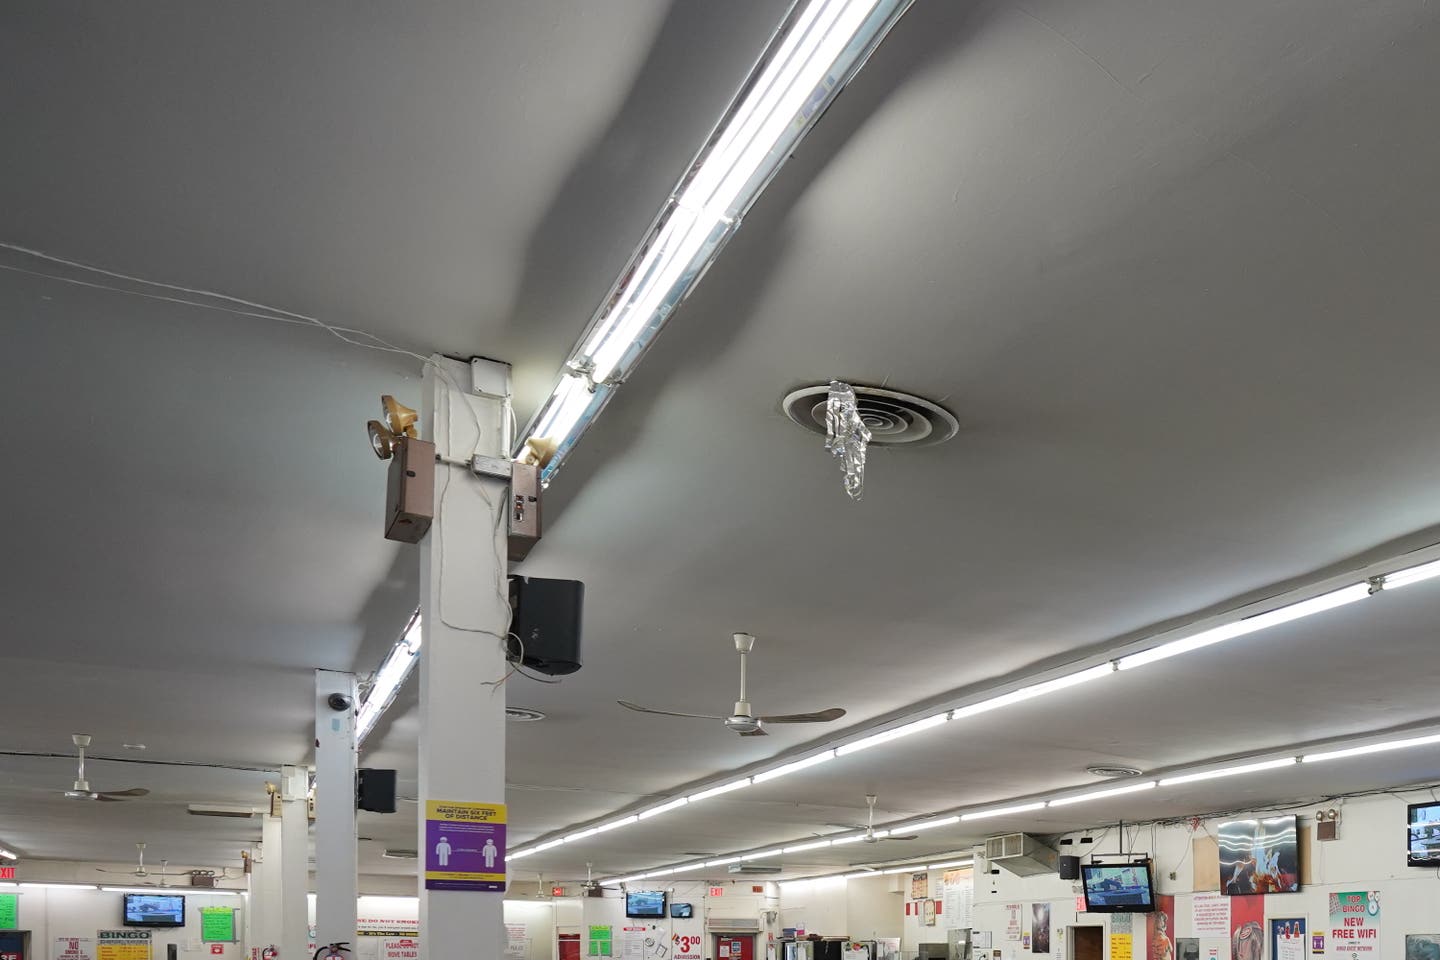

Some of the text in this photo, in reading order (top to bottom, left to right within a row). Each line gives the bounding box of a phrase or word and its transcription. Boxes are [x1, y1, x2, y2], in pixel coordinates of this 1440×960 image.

[437, 807, 468, 815] MAINTAIN
[0, 867, 15, 879] XIT
[711, 887, 723, 896] EXIT
[1348, 895, 1360, 903] TOP
[1342, 905, 1365, 913] BINGO
[1344, 917, 1364, 926] NEW
[100, 931, 149, 939] BINGO
[1332, 929, 1355, 938] FREE
[1357, 928, 1376, 938] WIFI
[68, 942, 79, 950] NO
